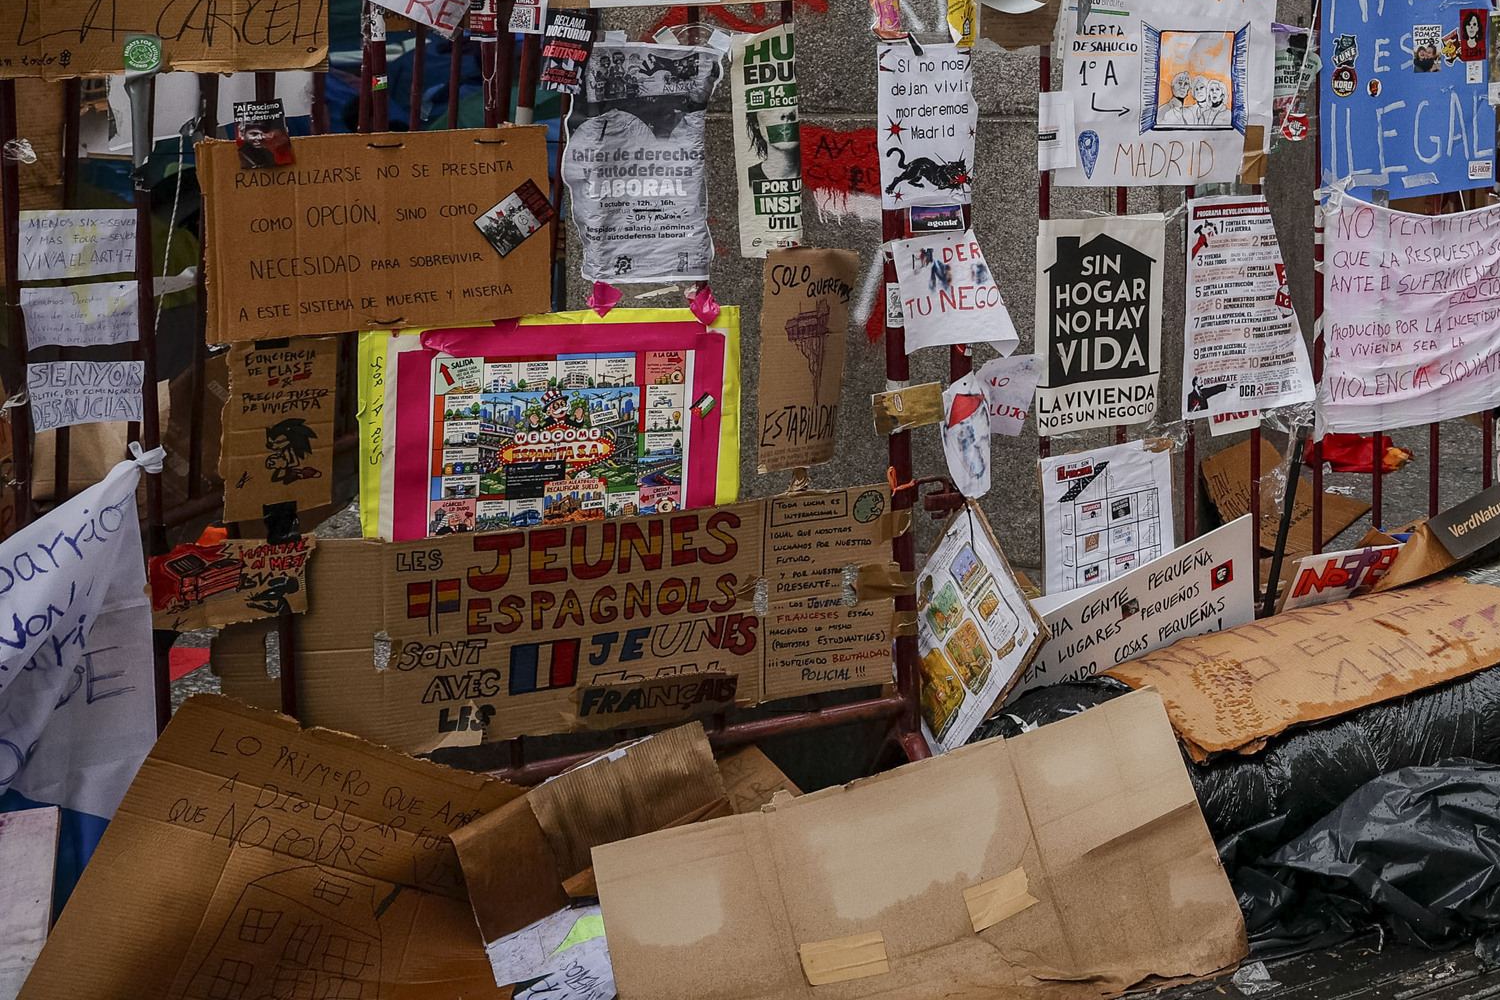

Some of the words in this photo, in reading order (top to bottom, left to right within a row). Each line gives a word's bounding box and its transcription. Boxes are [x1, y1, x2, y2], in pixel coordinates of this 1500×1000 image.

[545, 25, 592, 42] NOCTURNA
[554, 14, 586, 29] RECLAMA
[543, 45, 587, 62] RENTISMO
[1073, 40, 1138, 53] DESAHUCIO
[898, 60, 910, 72] Si
[920, 60, 935, 72] no
[941, 58, 964, 71] nos
[768, 86, 786, 98] 14
[891, 84, 928, 97] dejan
[935, 81, 969, 93] vivir
[895, 103, 968, 119] morderemos
[911, 126, 955, 140] Madrid
[1330, 90, 1494, 183] ILEGAL
[572, 149, 610, 162] taller
[613, 149, 629, 161] de
[634, 146, 705, 161] derechos
[1113, 141, 1215, 180] MADRID
[235, 166, 362, 190] RADICALIZARSE
[376, 165, 400, 181] NO
[411, 163, 430, 178] SE
[441, 160, 514, 177] PRESENTA
[588, 179, 687, 198] LABORAL
[762, 182, 788, 194] POR
[250, 215, 293, 234] COMO
[306, 198, 381, 228] OPCIÓN,
[396, 207, 427, 222] SINO
[439, 202, 478, 218] COMO
[768, 216, 798, 230] ÚTIL
[1337, 206, 1376, 240] NO
[942, 242, 980, 264] DER
[1081, 254, 1120, 276] SIN
[250, 253, 361, 281] NECESIDAD
[370, 258, 400, 270] PARA
[409, 251, 484, 269] SOBREVIVIR
[771, 264, 810, 296] SOLO
[1055, 277, 1147, 308] HOGAR
[239, 308, 249, 322] A
[257, 305, 292, 319] ESTE
[300, 298, 354, 315] SISTEMA
[361, 296, 378, 309] DE
[386, 290, 439, 306] MUERTE
[446, 288, 453, 300] Y
[462, 283, 513, 299] MISERIA
[1055, 313, 1091, 337] NO
[1095, 305, 1146, 331] HAY
[245, 350, 316, 367] CONCIENCIA
[450, 359, 475, 370] SALIDA
[1055, 334, 1146, 376] VIDA
[29, 362, 142, 389] SENYOR
[248, 363, 263, 376] DE
[268, 361, 312, 378] CLASE
[242, 390, 283, 403] PRECIO
[287, 388, 329, 401] JUSTO
[1038, 395, 1061, 414] LA
[1066, 384, 1155, 410] VIVIENDA
[1239, 385, 1255, 397] OCR
[242, 401, 258, 414] DE
[261, 400, 321, 415] VIVIENDA
[1039, 416, 1059, 429] NO
[1060, 413, 1073, 425] ES
[1076, 411, 1095, 423] UN
[1098, 402, 1154, 421] NEGOCIO
[515, 428, 600, 443] WELCOME
[547, 484, 580, 493] RECALIFICAR
[784, 510, 838, 519] INTERNACIONAL
[397, 551, 443, 573] LES
[467, 512, 740, 592] JEUNES
[1148, 547, 1213, 590] PEQUEÑA
[467, 573, 739, 635] ESPAGNOLS
[777, 611, 839, 623] FRANCESES
[848, 608, 874, 617] ESTÁN
[1081, 586, 1129, 625] GENTE
[1141, 584, 1200, 621] PEQUEÑOS
[1158, 596, 1226, 642] PEQUEÑAS
[589, 614, 759, 667] JEUNES
[1058, 620, 1122, 663] LUGARES
[1114, 634, 1148, 664] COSAS
[397, 640, 488, 671] SONT
[832, 650, 889, 664] BRUTALIDAD
[801, 668, 851, 680] POLICIAL
[1023, 660, 1047, 685] EN
[421, 669, 501, 704] AVEC
[579, 678, 738, 717] FRANÇAIS
[438, 704, 496, 733] LES
[210, 728, 262, 758] LO
[273, 746, 370, 798] PRIMERO
[382, 785, 423, 815] QUE
[168, 797, 206, 826] QUE
[213, 803, 270, 852] NO
